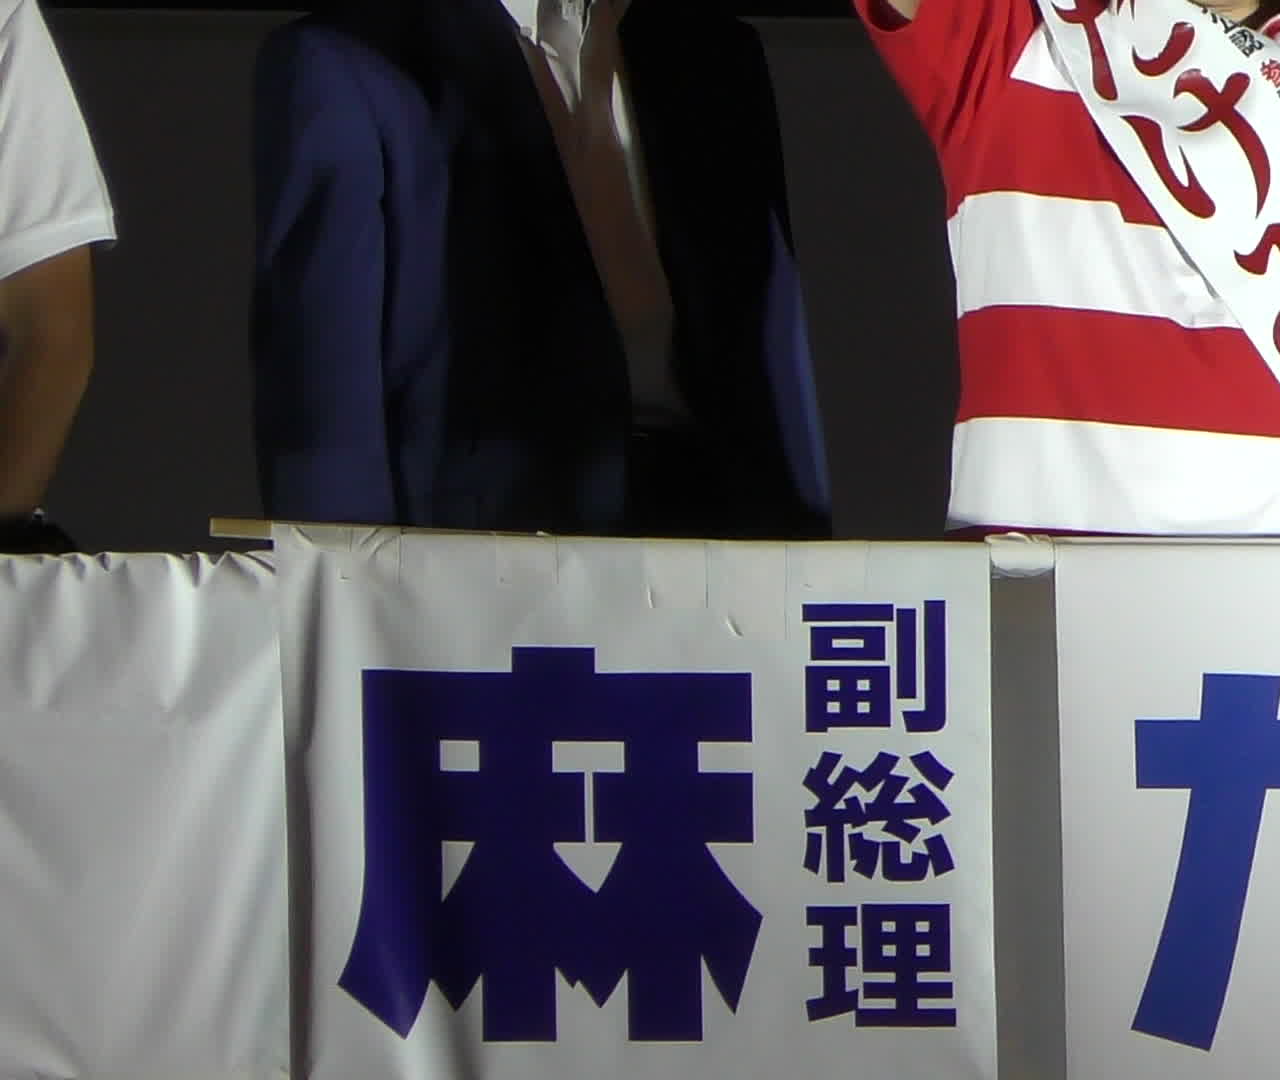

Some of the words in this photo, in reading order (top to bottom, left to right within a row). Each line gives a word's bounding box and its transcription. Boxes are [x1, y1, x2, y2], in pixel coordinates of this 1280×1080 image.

[337, 645, 764, 1043] 麻
[801, 599, 958, 1029] 副総理
